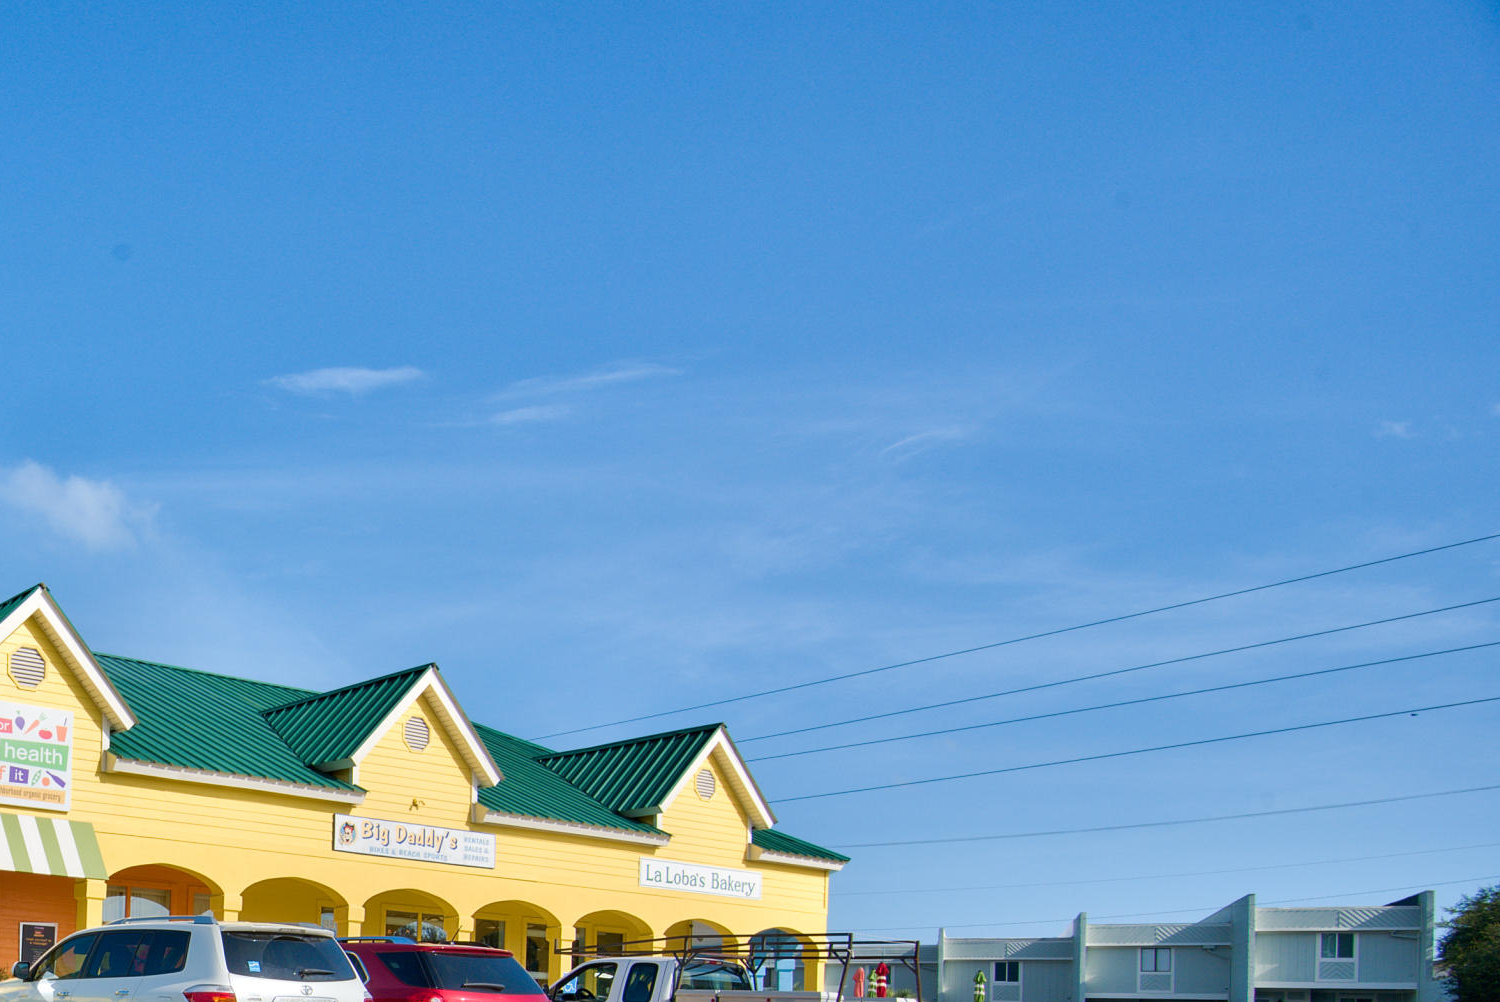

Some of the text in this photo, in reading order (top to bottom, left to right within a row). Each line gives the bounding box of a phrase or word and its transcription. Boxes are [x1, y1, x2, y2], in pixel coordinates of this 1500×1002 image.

[4, 741, 63, 765] health
[14, 768, 24, 782] it
[361, 819, 458, 854] Big Daddy's
[646, 863, 756, 897] La Loba's Bakery
